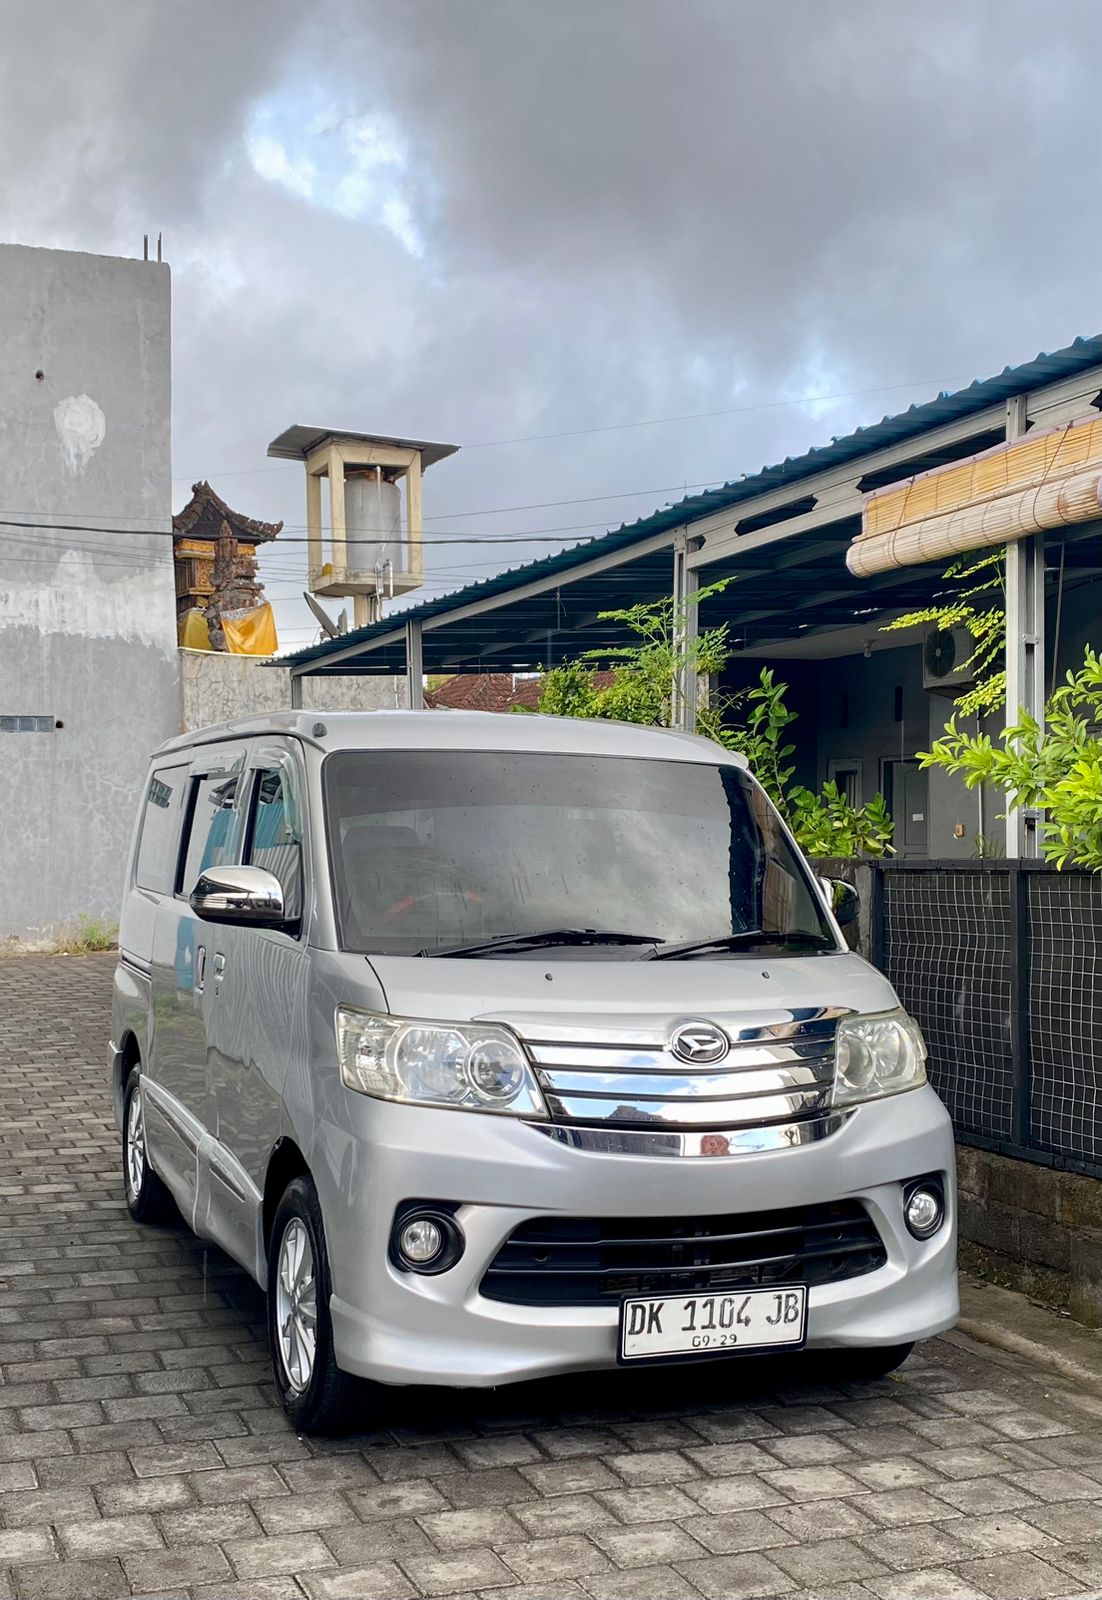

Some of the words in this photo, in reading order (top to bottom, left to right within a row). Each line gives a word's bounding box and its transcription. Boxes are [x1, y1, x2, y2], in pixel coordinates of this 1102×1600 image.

[628, 1303, 664, 1335] DK
[681, 1296, 752, 1331] 1104
[765, 1293, 799, 1325] JB
